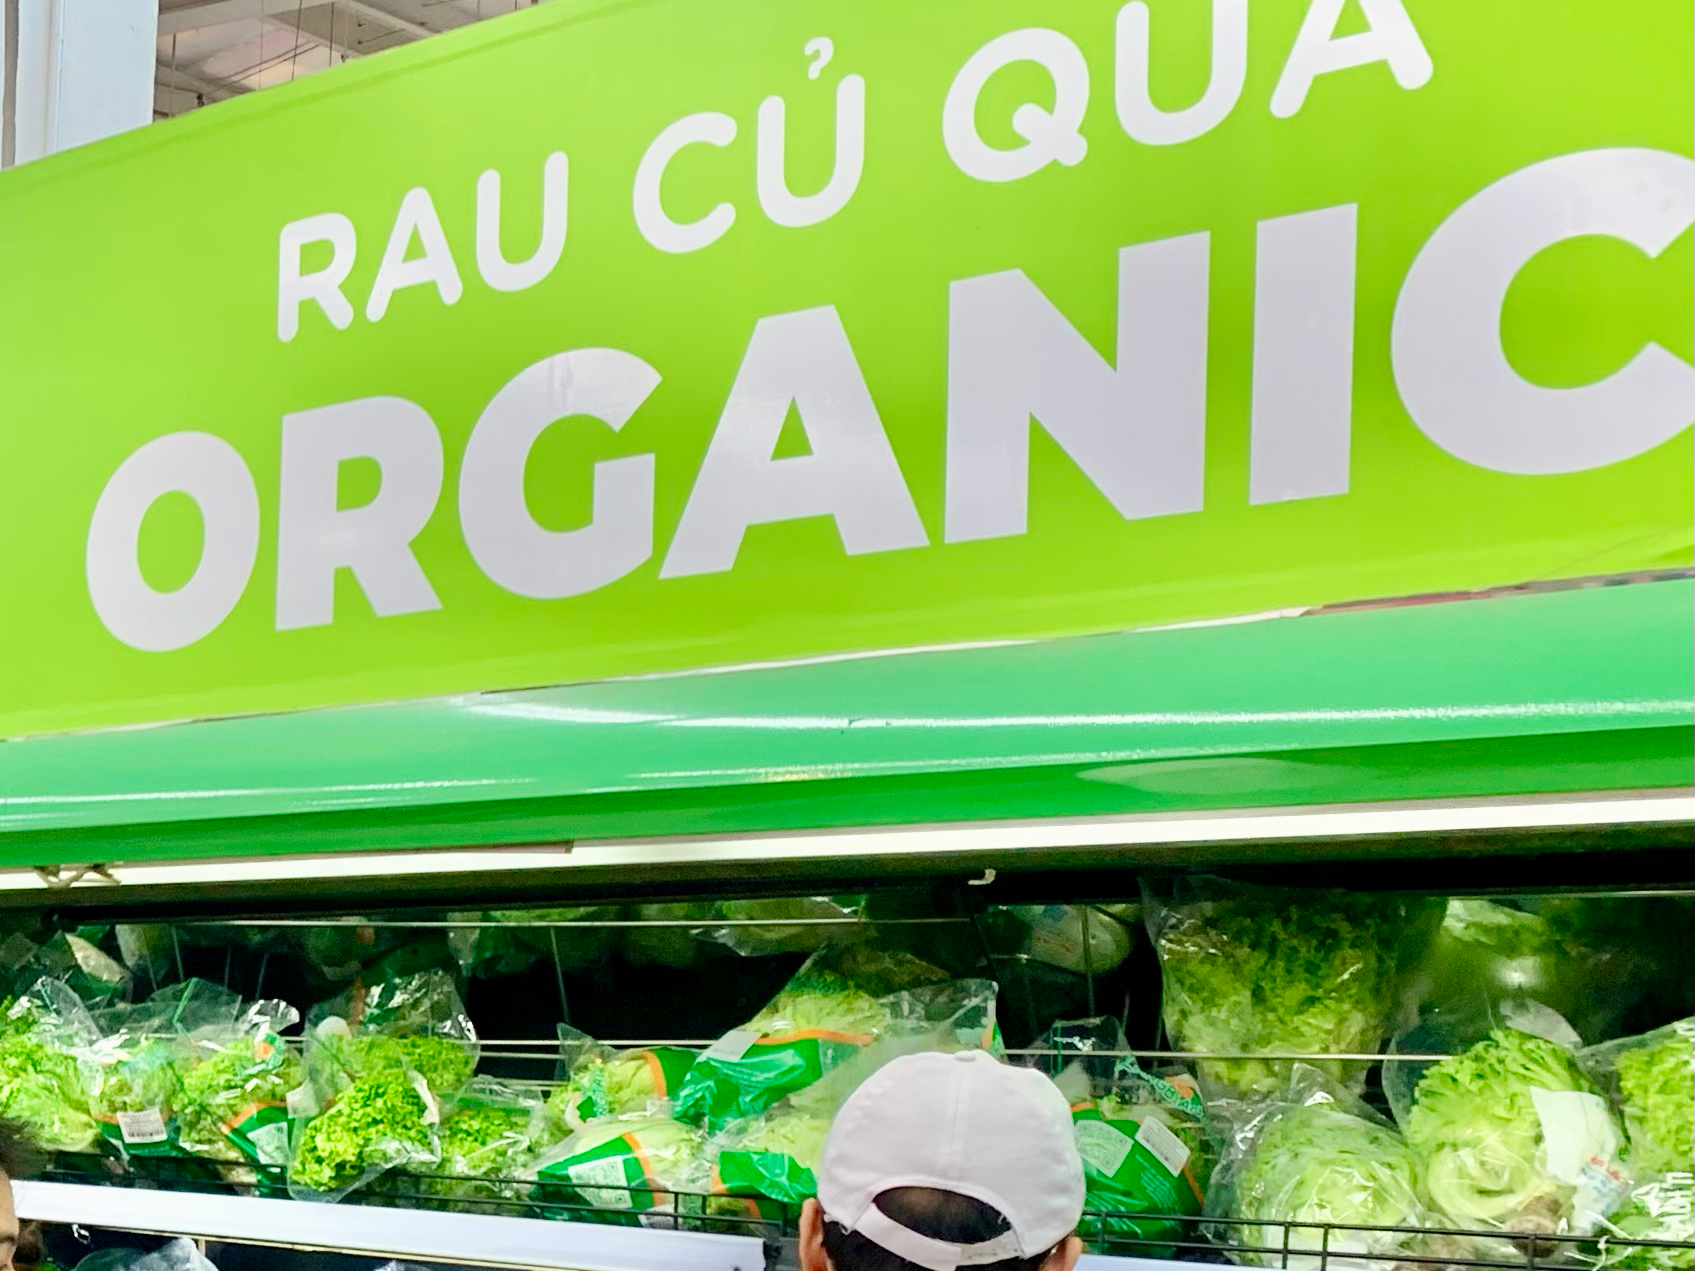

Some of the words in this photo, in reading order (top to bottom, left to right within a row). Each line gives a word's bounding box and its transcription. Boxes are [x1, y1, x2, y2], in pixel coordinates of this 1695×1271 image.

[277, 151, 569, 344] RAU
[632, 36, 866, 255] CỦ
[86, 147, 1695, 652] ORGANIC
